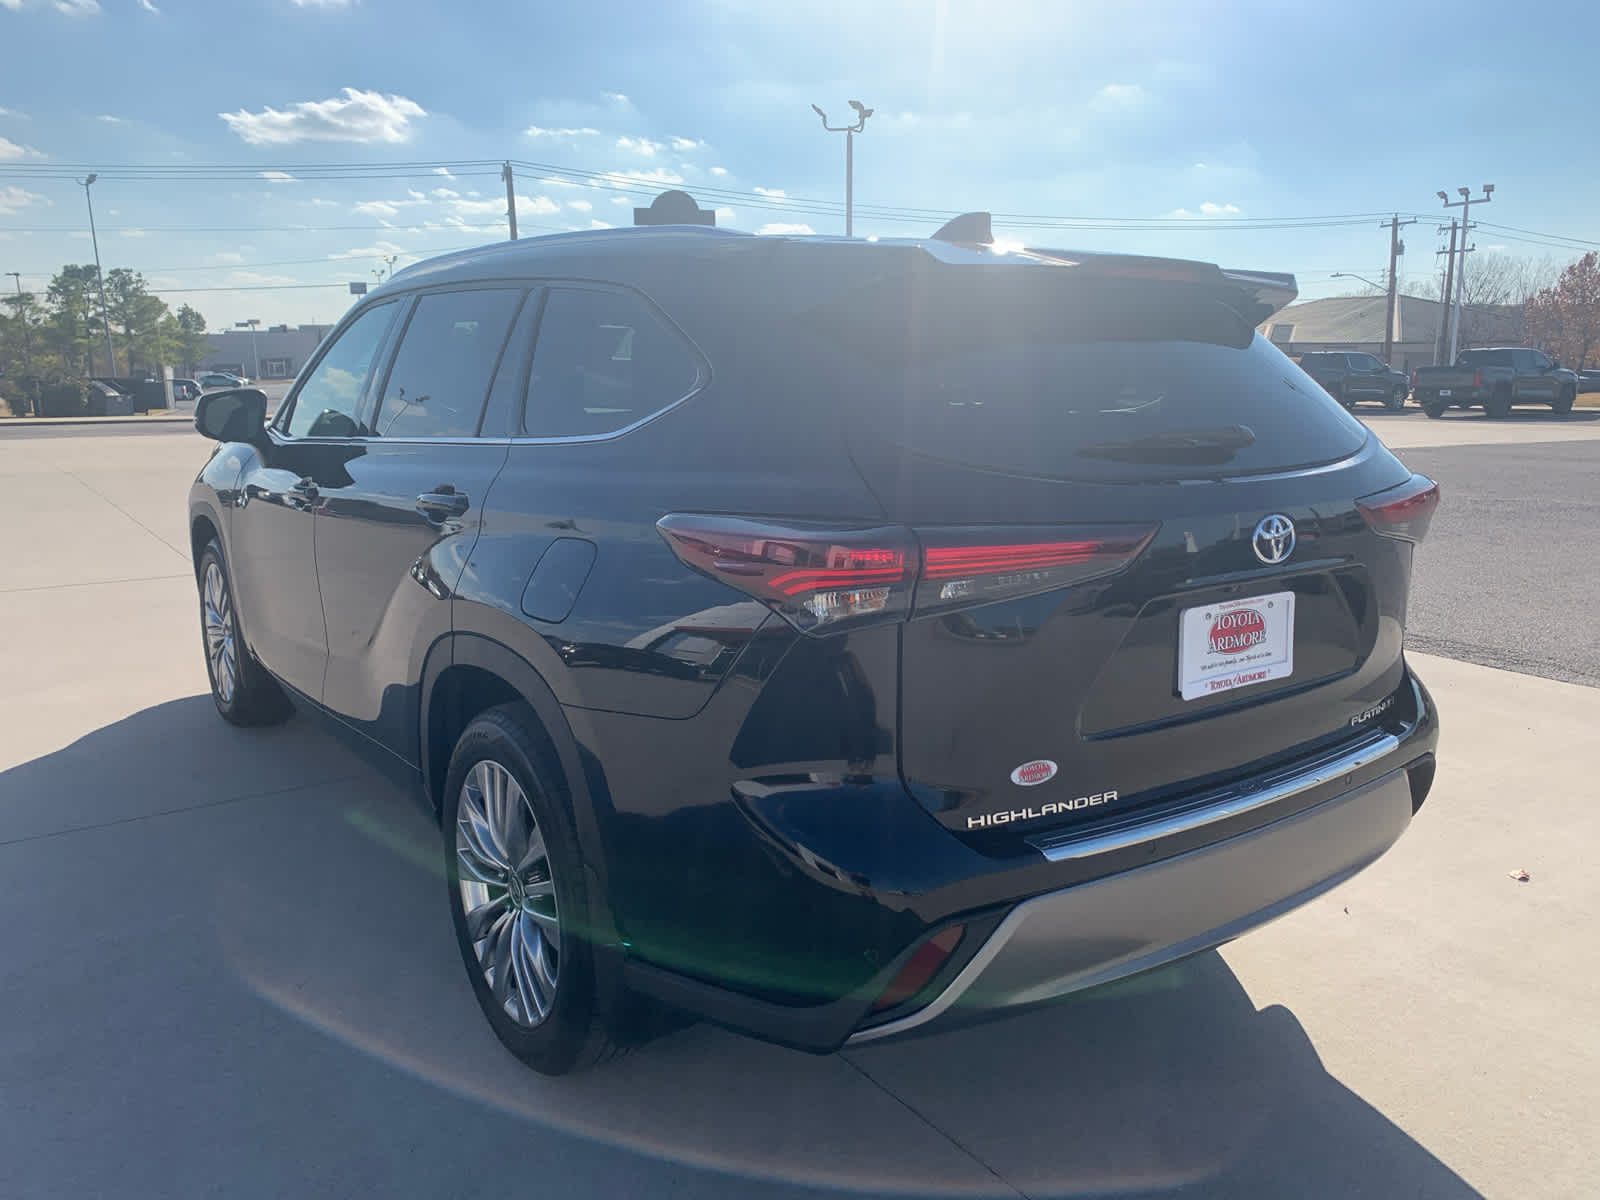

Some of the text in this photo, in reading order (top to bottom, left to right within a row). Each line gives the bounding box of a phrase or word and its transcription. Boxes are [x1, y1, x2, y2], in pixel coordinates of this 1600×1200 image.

[1215, 611, 1261, 630] TOYOTA
[1208, 630, 1266, 652] ARDMORE
[967, 790, 1119, 829] HIGHLANDER
